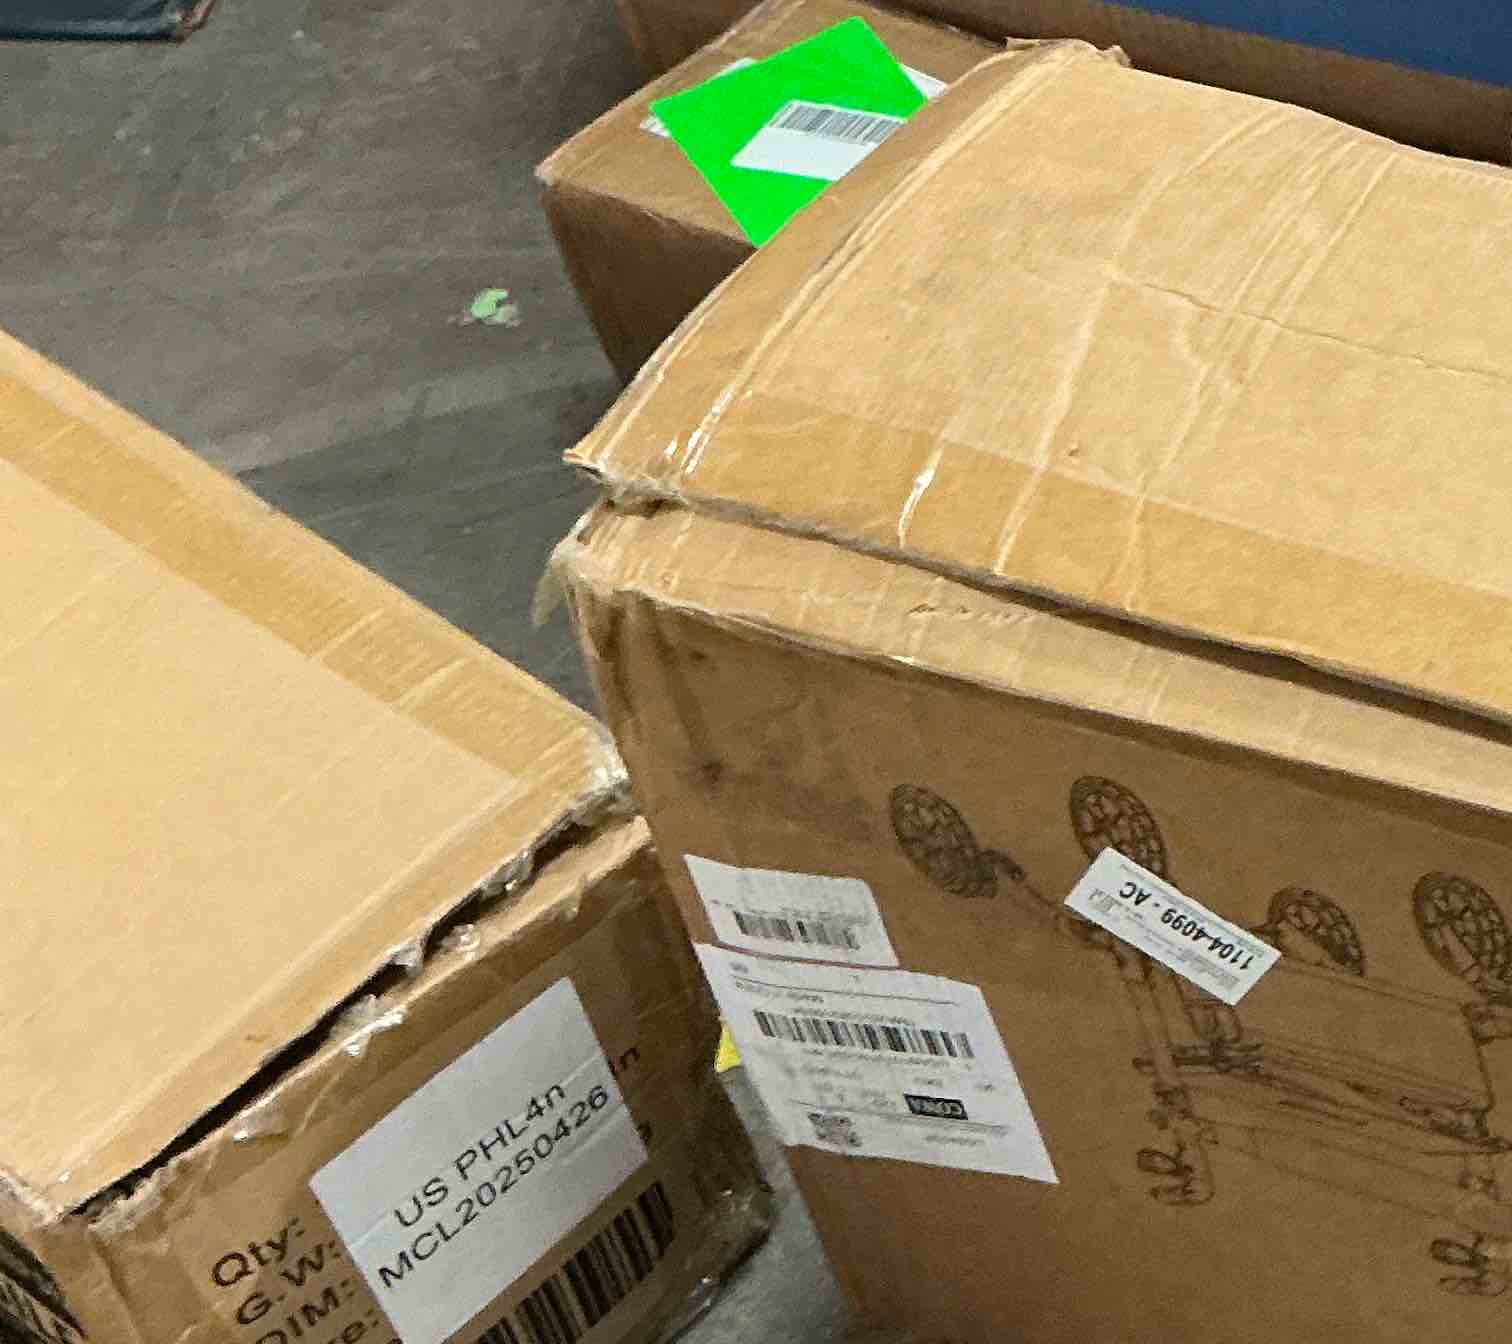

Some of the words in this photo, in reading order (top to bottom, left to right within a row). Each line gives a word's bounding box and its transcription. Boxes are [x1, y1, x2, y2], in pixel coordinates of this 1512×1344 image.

[1119, 881, 1152, 906] AC
[1160, 908, 1254, 971] 1104-4099
[377, 1085, 609, 1288] MCL20250426
[393, 1176, 450, 1228] US
[453, 1083, 566, 1181] PHL4n
[210, 1216, 305, 1288] Qty:
